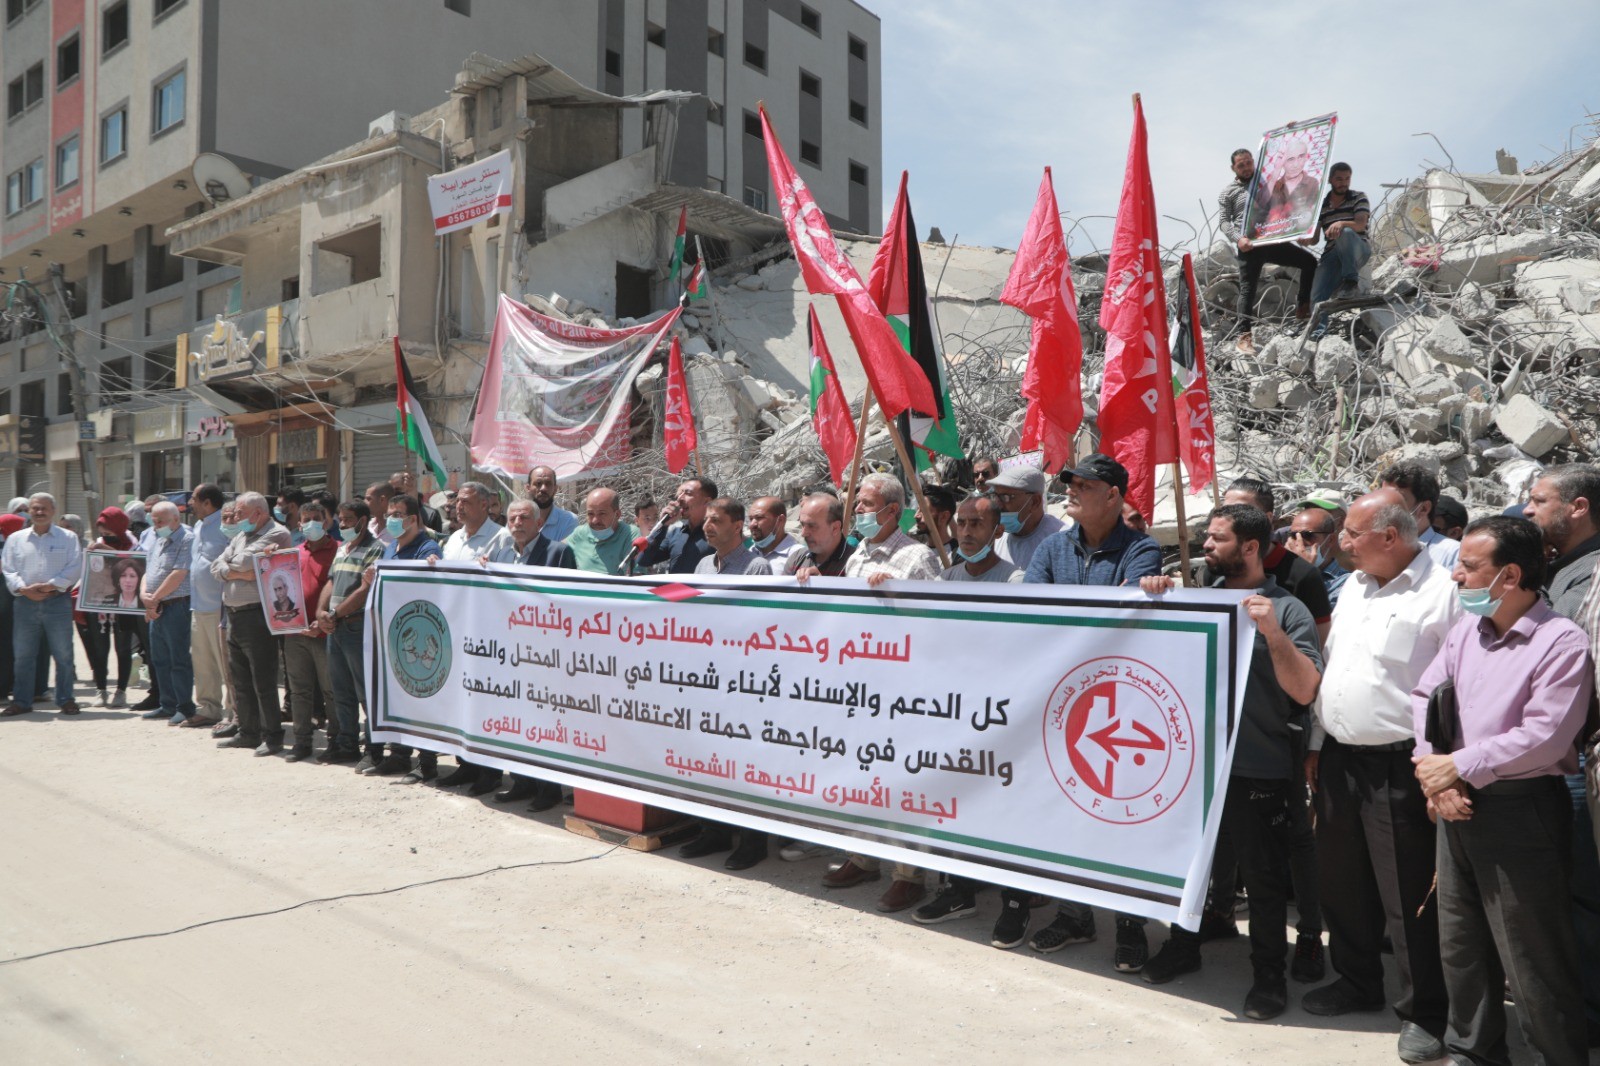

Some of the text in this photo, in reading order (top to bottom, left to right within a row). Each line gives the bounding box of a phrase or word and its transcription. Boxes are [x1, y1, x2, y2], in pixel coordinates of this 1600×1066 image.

[561, 321, 587, 338] Pain
[508, 603, 911, 665] لستم وحدكم... مساندون لكم ولثباتكم
[463, 636, 1010, 732] كل الدعم والإسناد لأبناء شعبنا في الداخل المحتل والضفة
[462, 672, 1013, 787] والقدس في مواجهة حملة الاعتقالات الصهيونية الممنهجة
[483, 717, 607, 756] لجنة الأسرى للقوى
[665, 749, 957, 824] لجنة الأسرى للجبهة الشعبية
